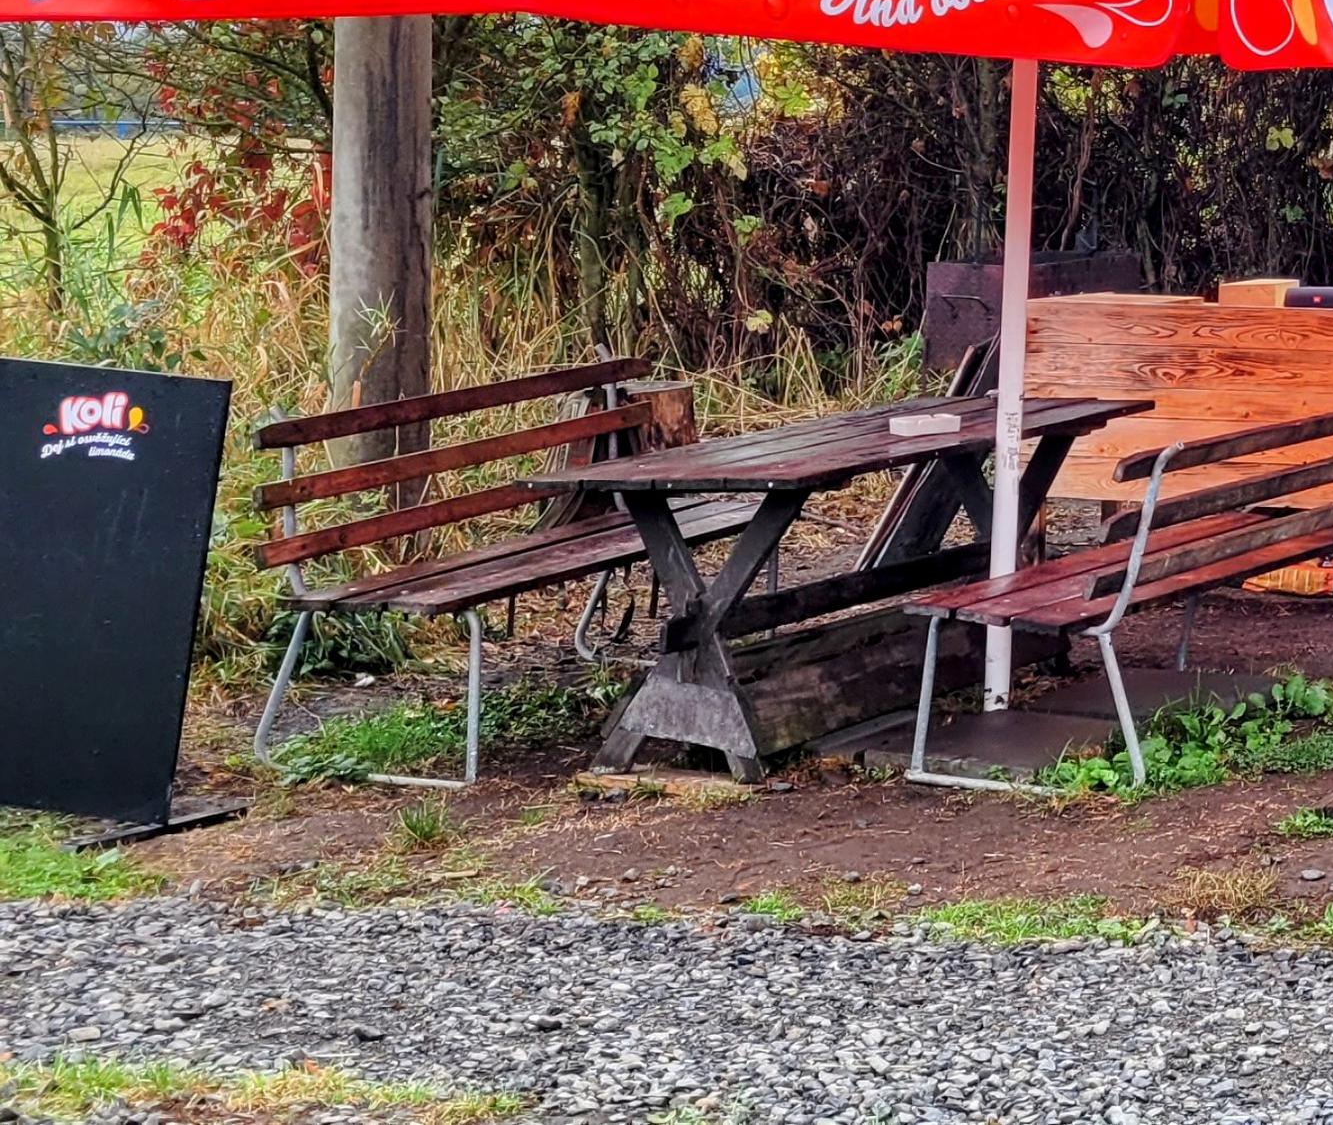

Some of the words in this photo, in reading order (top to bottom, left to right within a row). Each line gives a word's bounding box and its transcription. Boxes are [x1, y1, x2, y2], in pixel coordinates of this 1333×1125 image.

[60, 391, 129, 435] Koli
[40, 440, 64, 458] Dej
[64, 436, 77, 449] si
